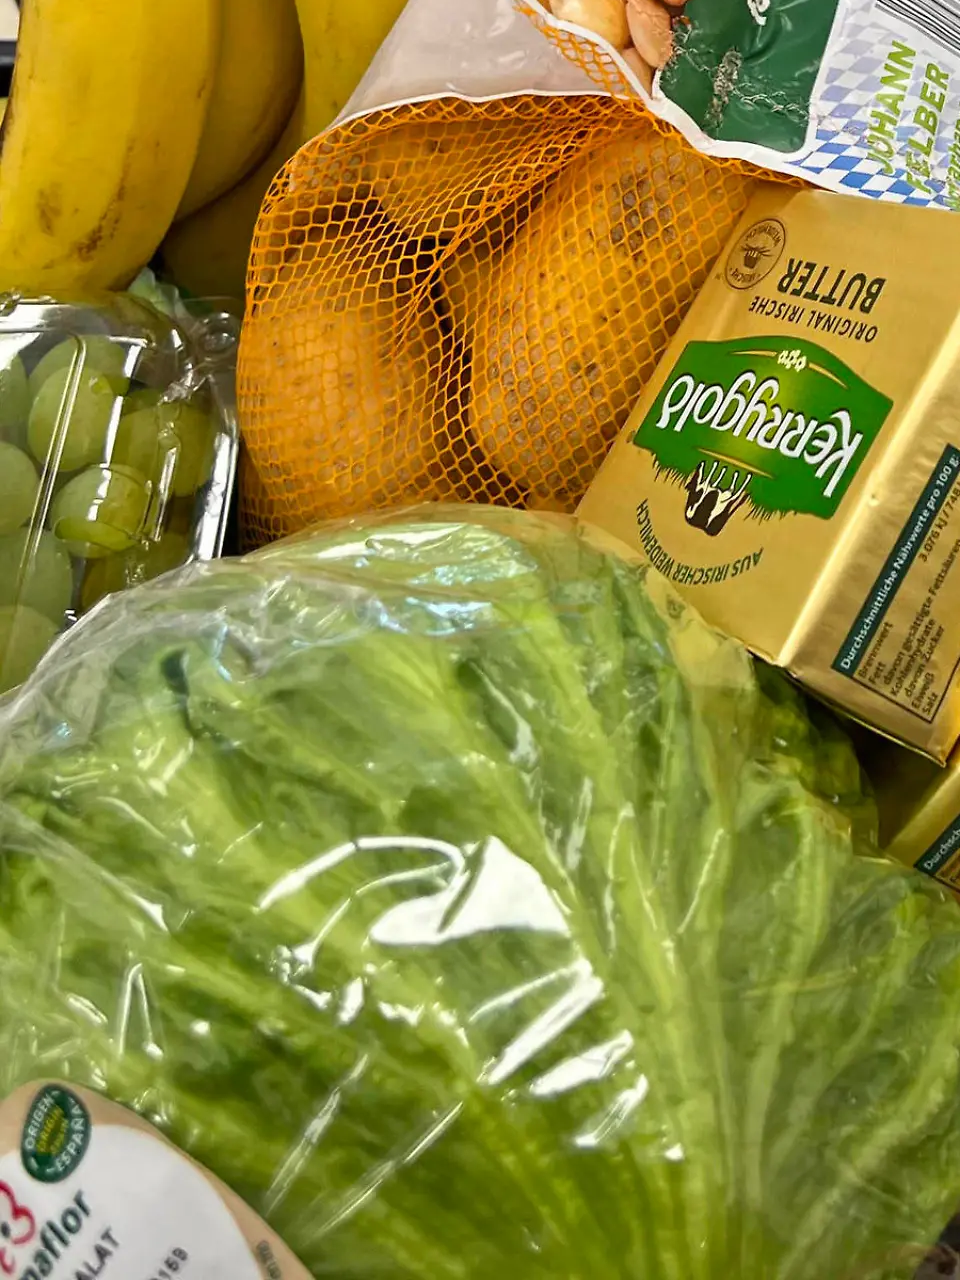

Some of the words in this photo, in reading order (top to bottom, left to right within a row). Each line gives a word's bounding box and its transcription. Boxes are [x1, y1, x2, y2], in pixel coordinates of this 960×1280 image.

[863, 40, 917, 174] JOHANN
[902, 61, 952, 193] FELBER
[748, 294, 804, 324] IRISCHE
[776, 256, 885, 316] BUTTER
[806, 309, 878, 343] ORIGINAL
[655, 371, 863, 497] Kerrygold
[636, 497, 674, 576] WEIDEMILCH
[730, 547, 763, 576] AUS
[672, 562, 729, 585] IRISCHER
[839, 568, 899, 670] Durchschnittliche
[891, 507, 931, 570] Nährwerte
[924, 486, 942, 511] pro
[935, 464, 953, 488] 100
[24, 1092, 54, 1148] ORIGEN
